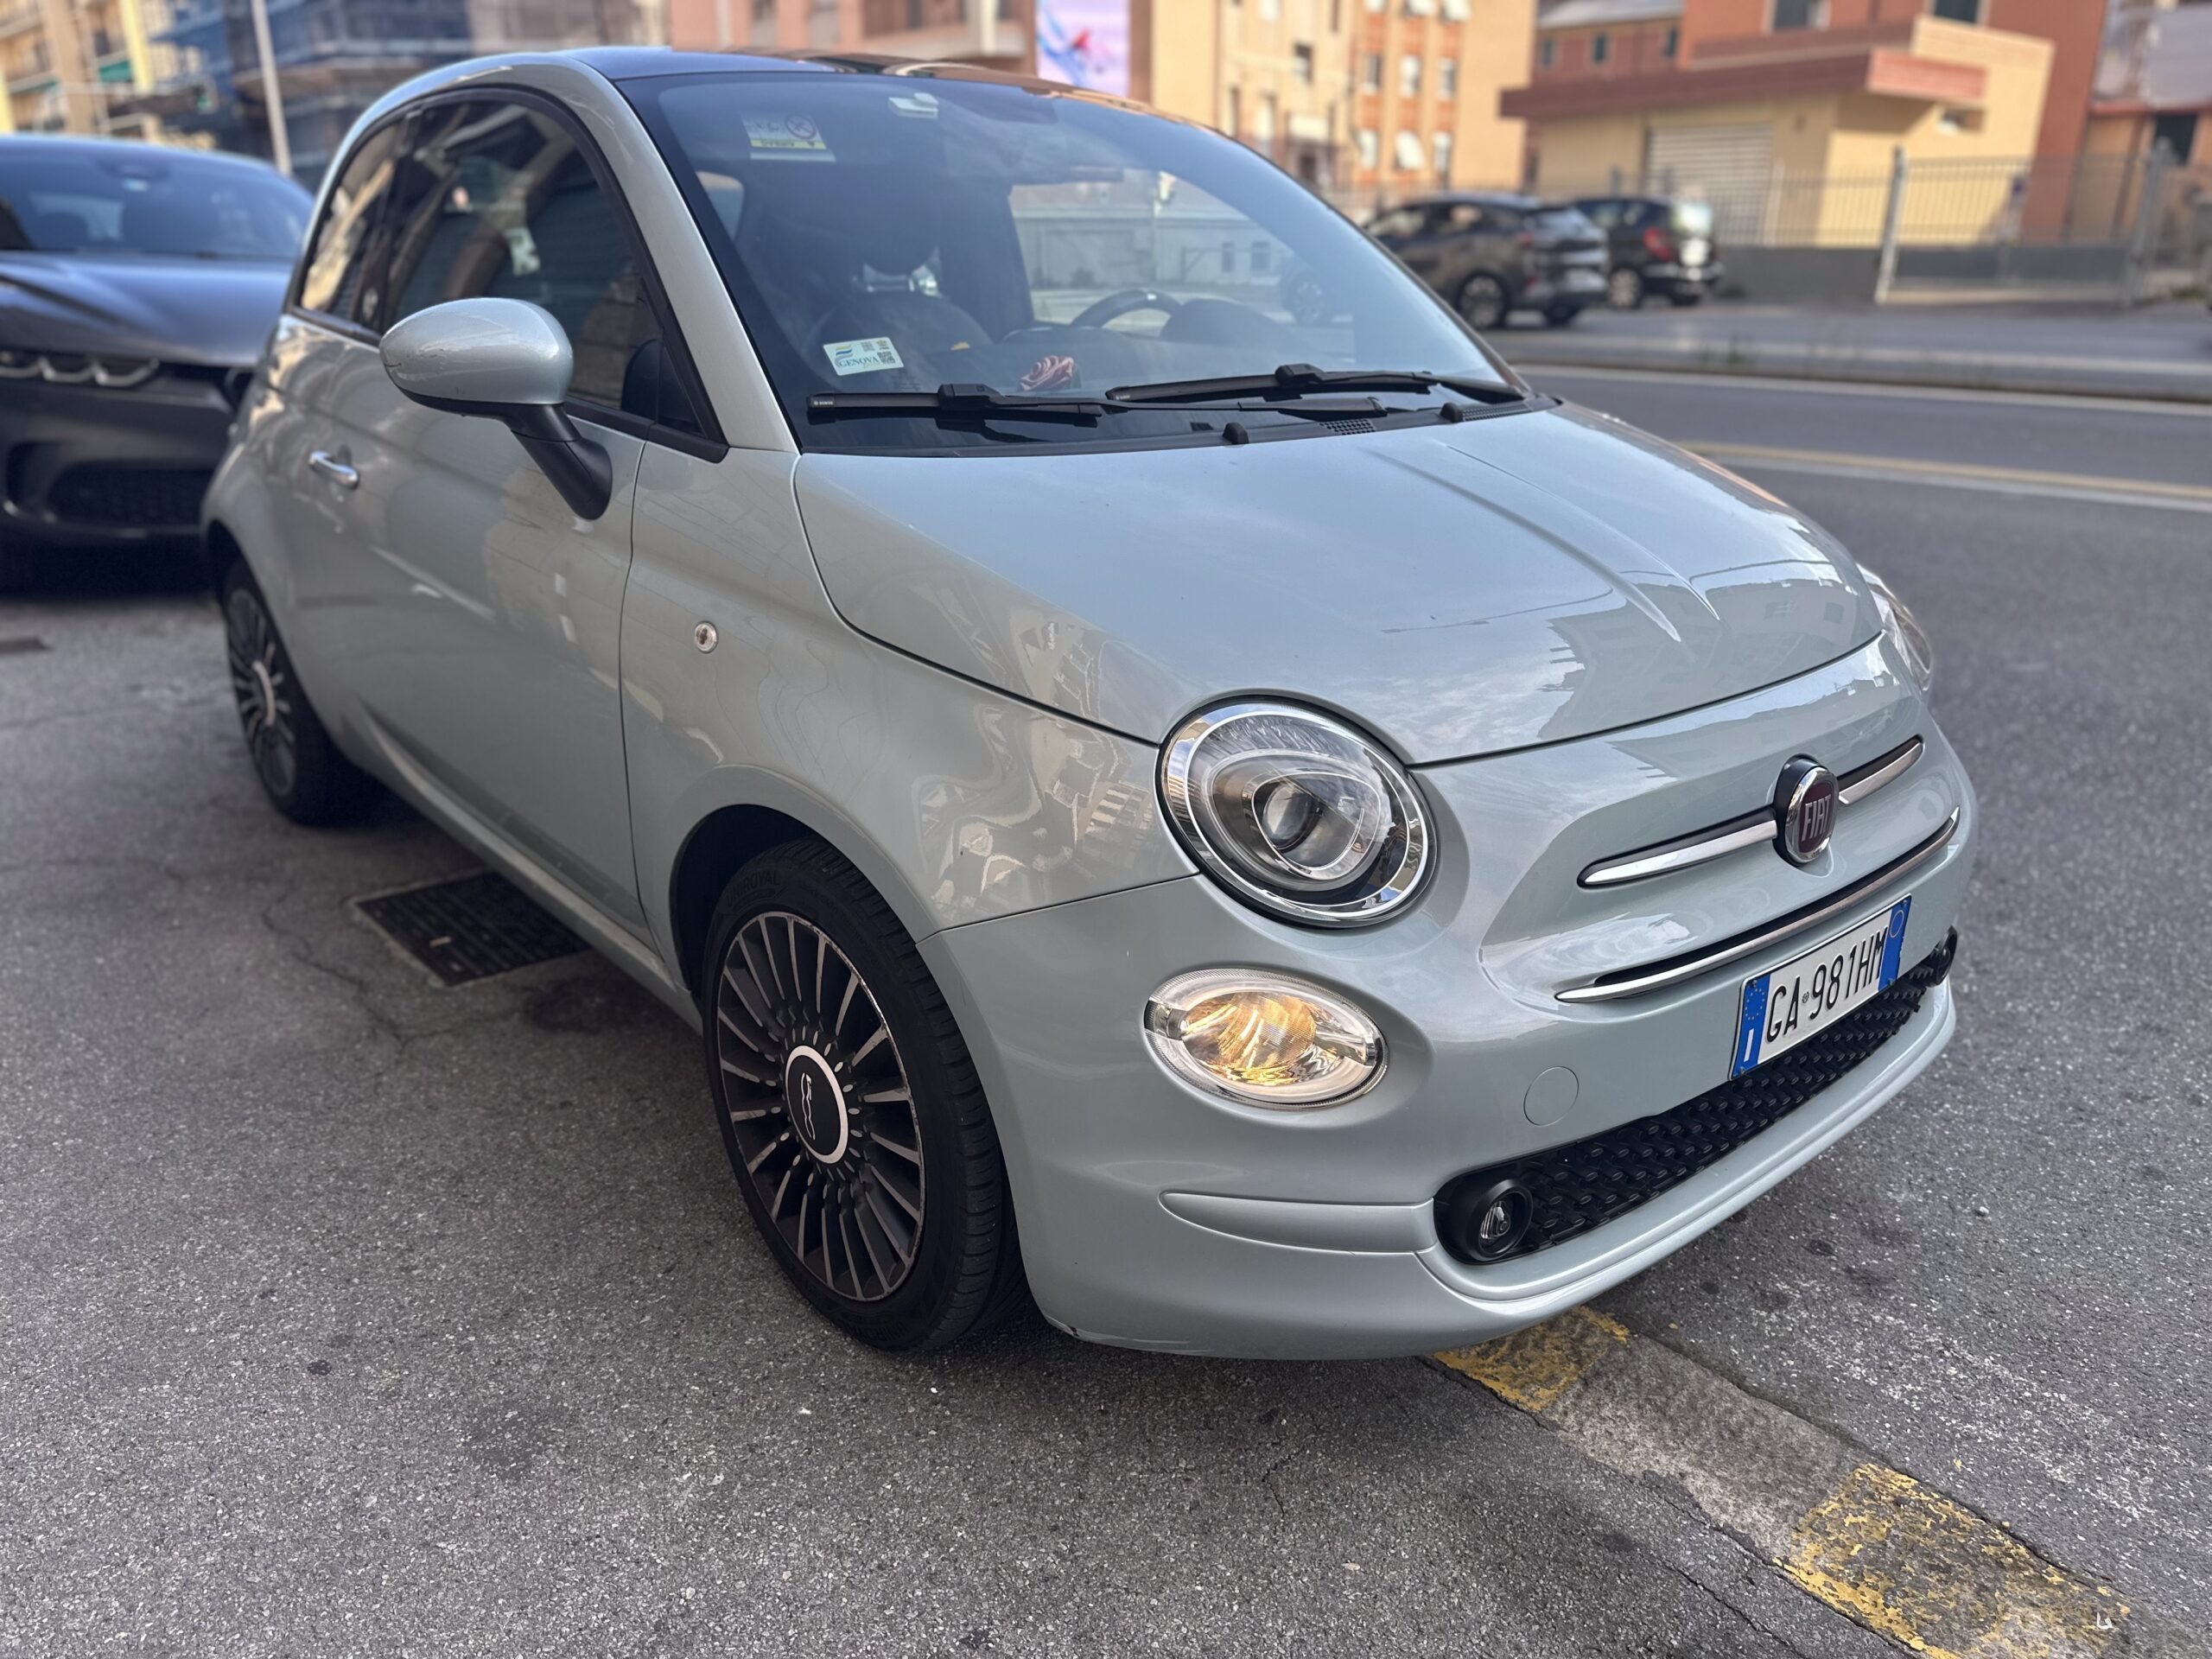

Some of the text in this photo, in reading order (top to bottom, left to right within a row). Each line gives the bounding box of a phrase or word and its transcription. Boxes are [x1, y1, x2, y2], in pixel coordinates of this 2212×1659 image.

[839, 356, 879, 367] GENOVA
[1802, 794, 1832, 842] FIAT
[726, 870, 780, 907] UNIROYAL
[1766, 925, 1889, 1043] GA 981HM
